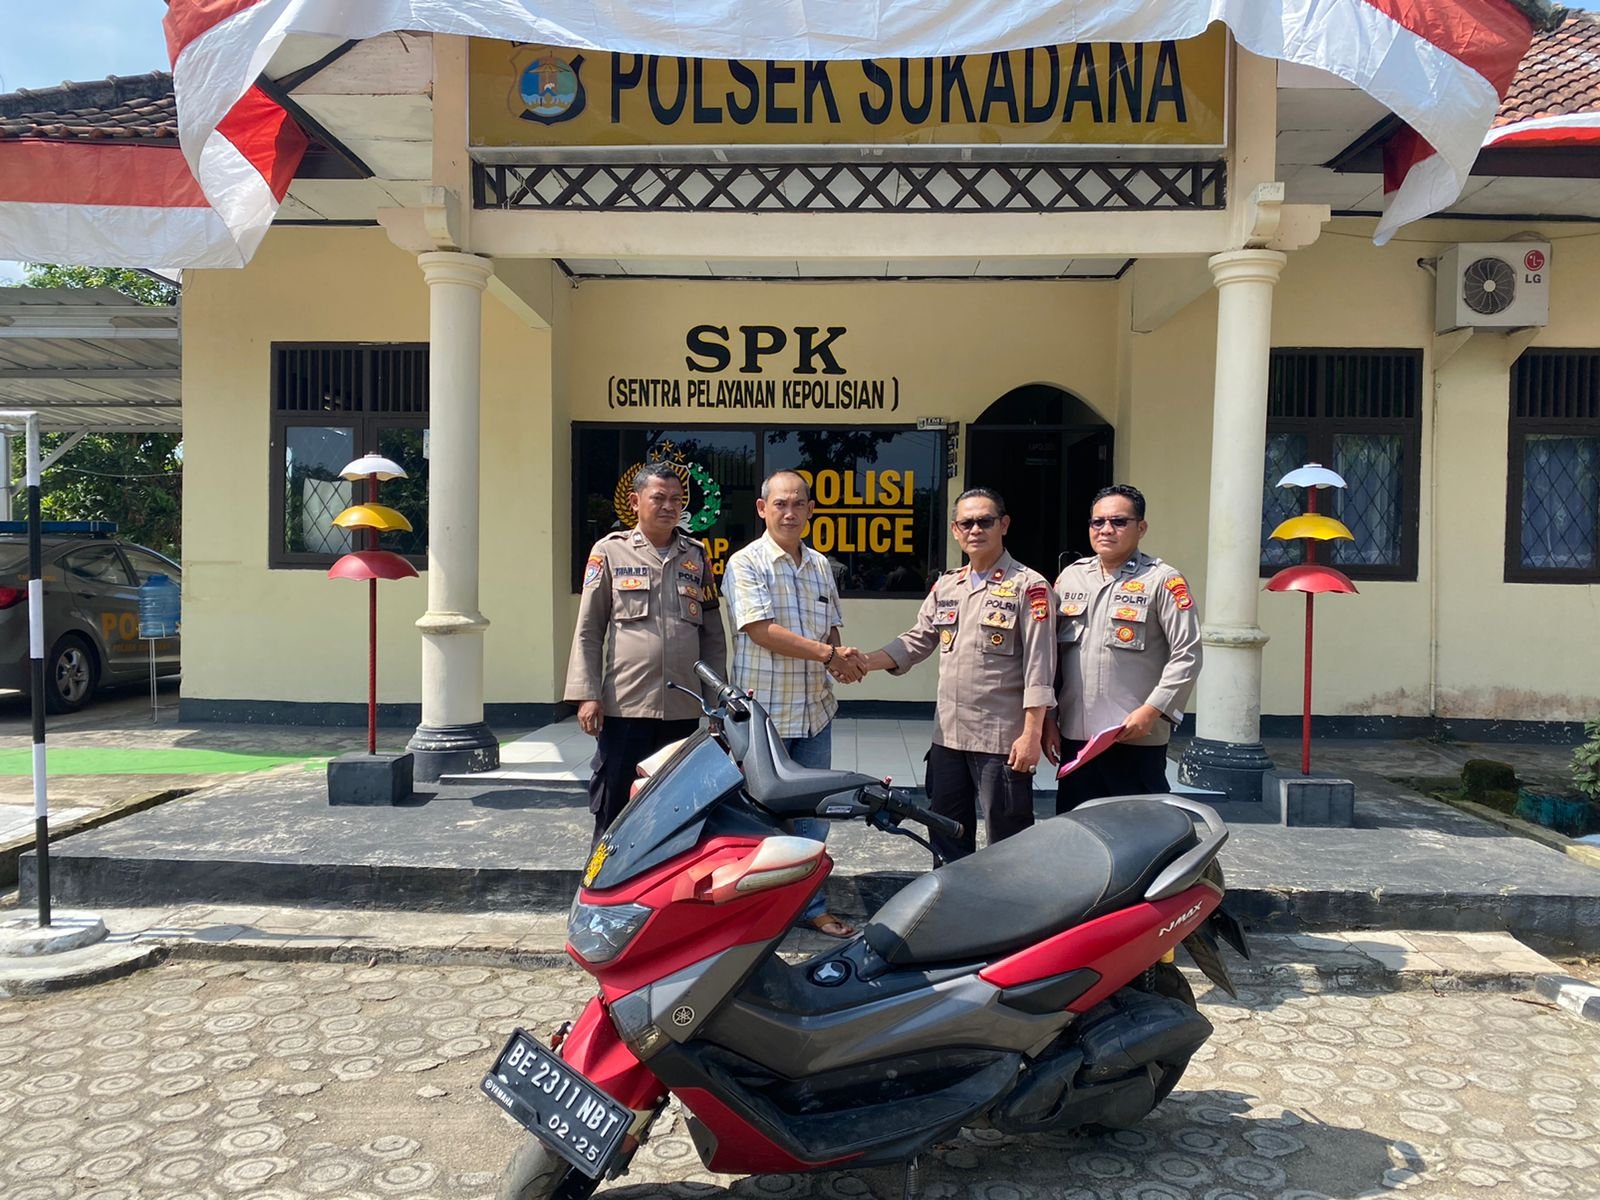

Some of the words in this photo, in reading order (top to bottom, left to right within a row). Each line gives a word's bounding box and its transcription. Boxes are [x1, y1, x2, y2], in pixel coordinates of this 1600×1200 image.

[611, 51, 841, 126] POLSEK
[858, 39, 1188, 126] SUKADANA
[1525, 274, 1542, 284] LG
[685, 324, 847, 375] SPK
[608, 376, 682, 409] (SENTRA
[687, 379, 775, 409] PELAYANAN
[985, 600, 1016, 611] POLRI
[1064, 592, 1088, 600] BUDI
[1114, 594, 1148, 605] POLRI
[490, 1082, 514, 1109] YAMAHA
[507, 1043, 538, 1076] BE
[531, 1061, 582, 1110] 2311
[576, 1094, 619, 1138] NBT
